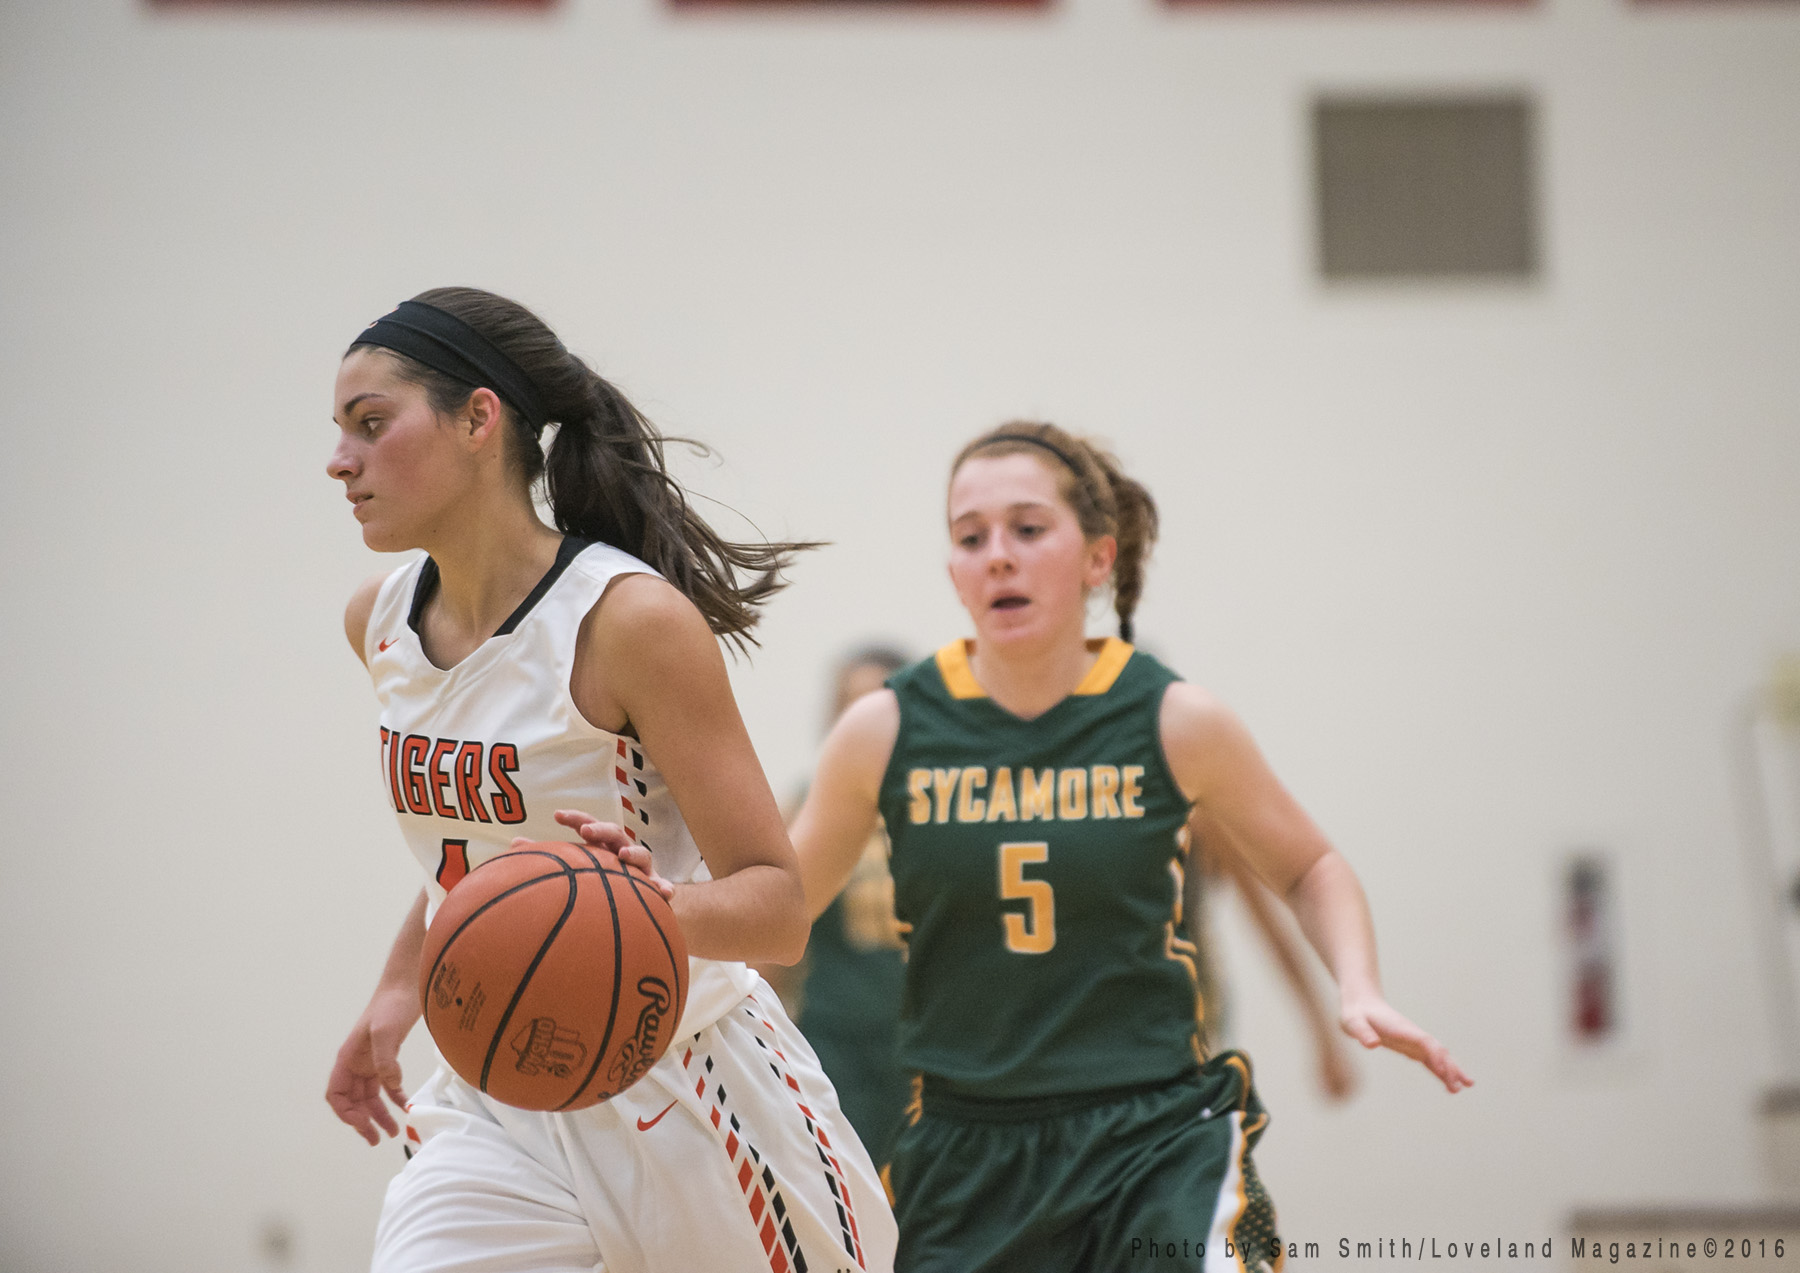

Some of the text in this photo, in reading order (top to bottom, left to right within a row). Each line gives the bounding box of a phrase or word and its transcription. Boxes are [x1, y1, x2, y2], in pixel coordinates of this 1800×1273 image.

[907, 764, 1146, 825] SYCAMORE
[999, 841, 1056, 954] 5
[597, 976, 671, 1099] Rawlin
